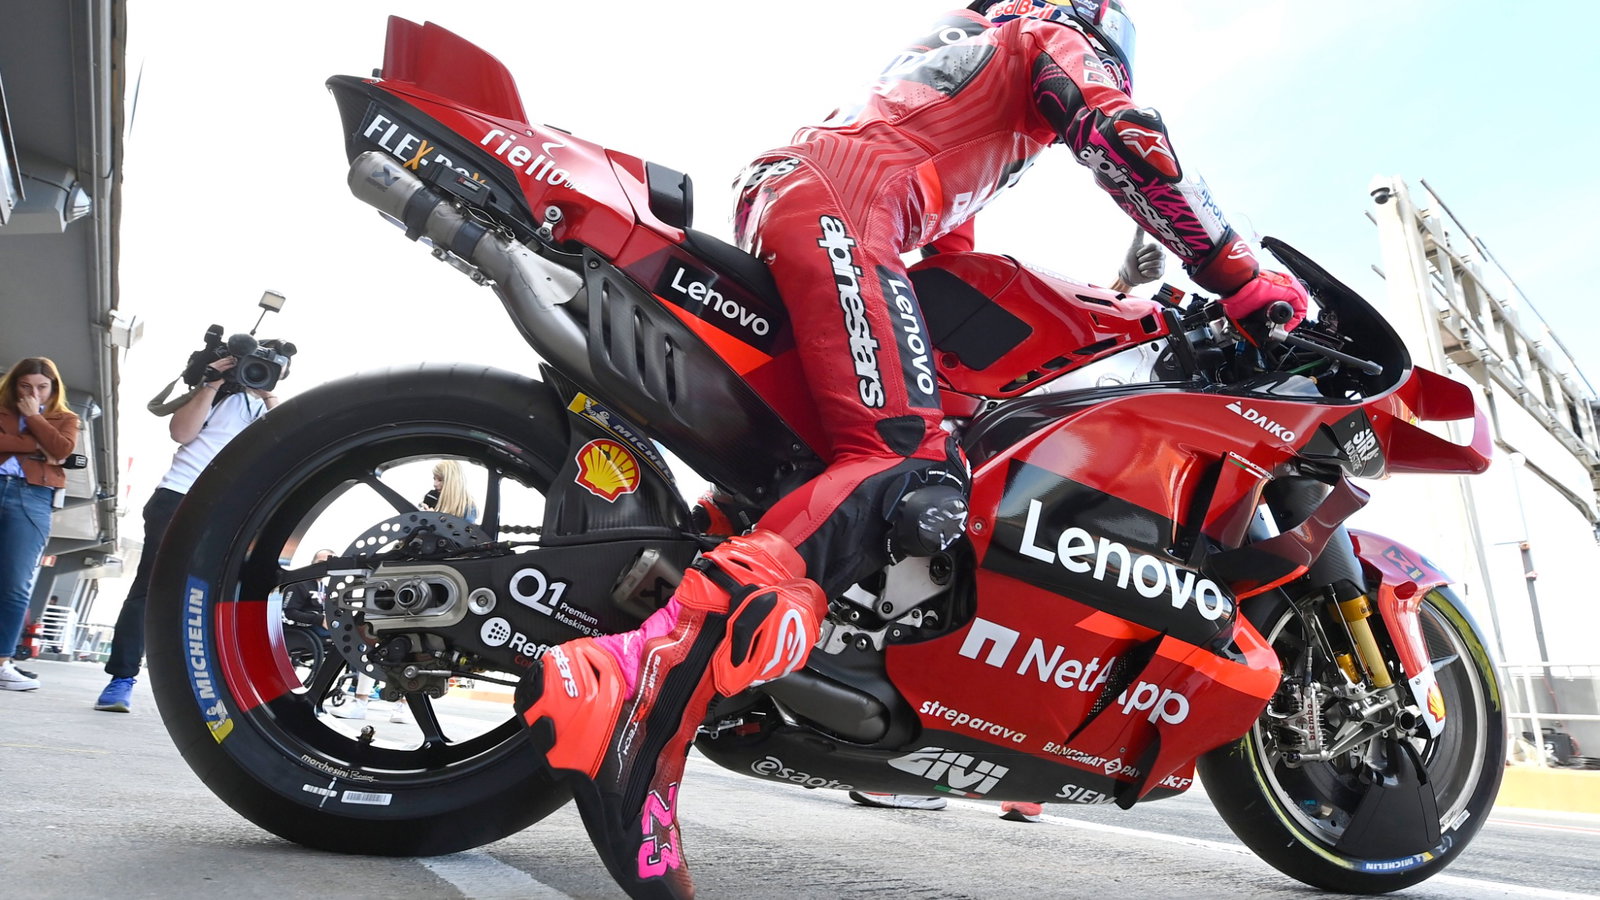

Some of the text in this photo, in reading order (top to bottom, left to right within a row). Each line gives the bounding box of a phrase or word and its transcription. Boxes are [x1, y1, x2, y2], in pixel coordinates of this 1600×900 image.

[480, 129, 570, 186] riello
[670, 267, 770, 336] Lenovo
[818, 215, 884, 408] alpinestars
[891, 279, 934, 396] Lenovo
[1242, 408, 1296, 442] DAIKO
[1019, 499, 1224, 621] Lenovo
[509, 568, 567, 616] Q1
[559, 602, 598, 625] Premium
[187, 588, 216, 699] MICHELIN
[555, 612, 591, 637] Masking
[919, 699, 1027, 744] streparava
[1306, 703, 1315, 741] brembo
[301, 754, 350, 778] marchesini
[1042, 742, 1141, 778] BANCOMAT PAY
[1366, 858, 1414, 870] MICHELIN
